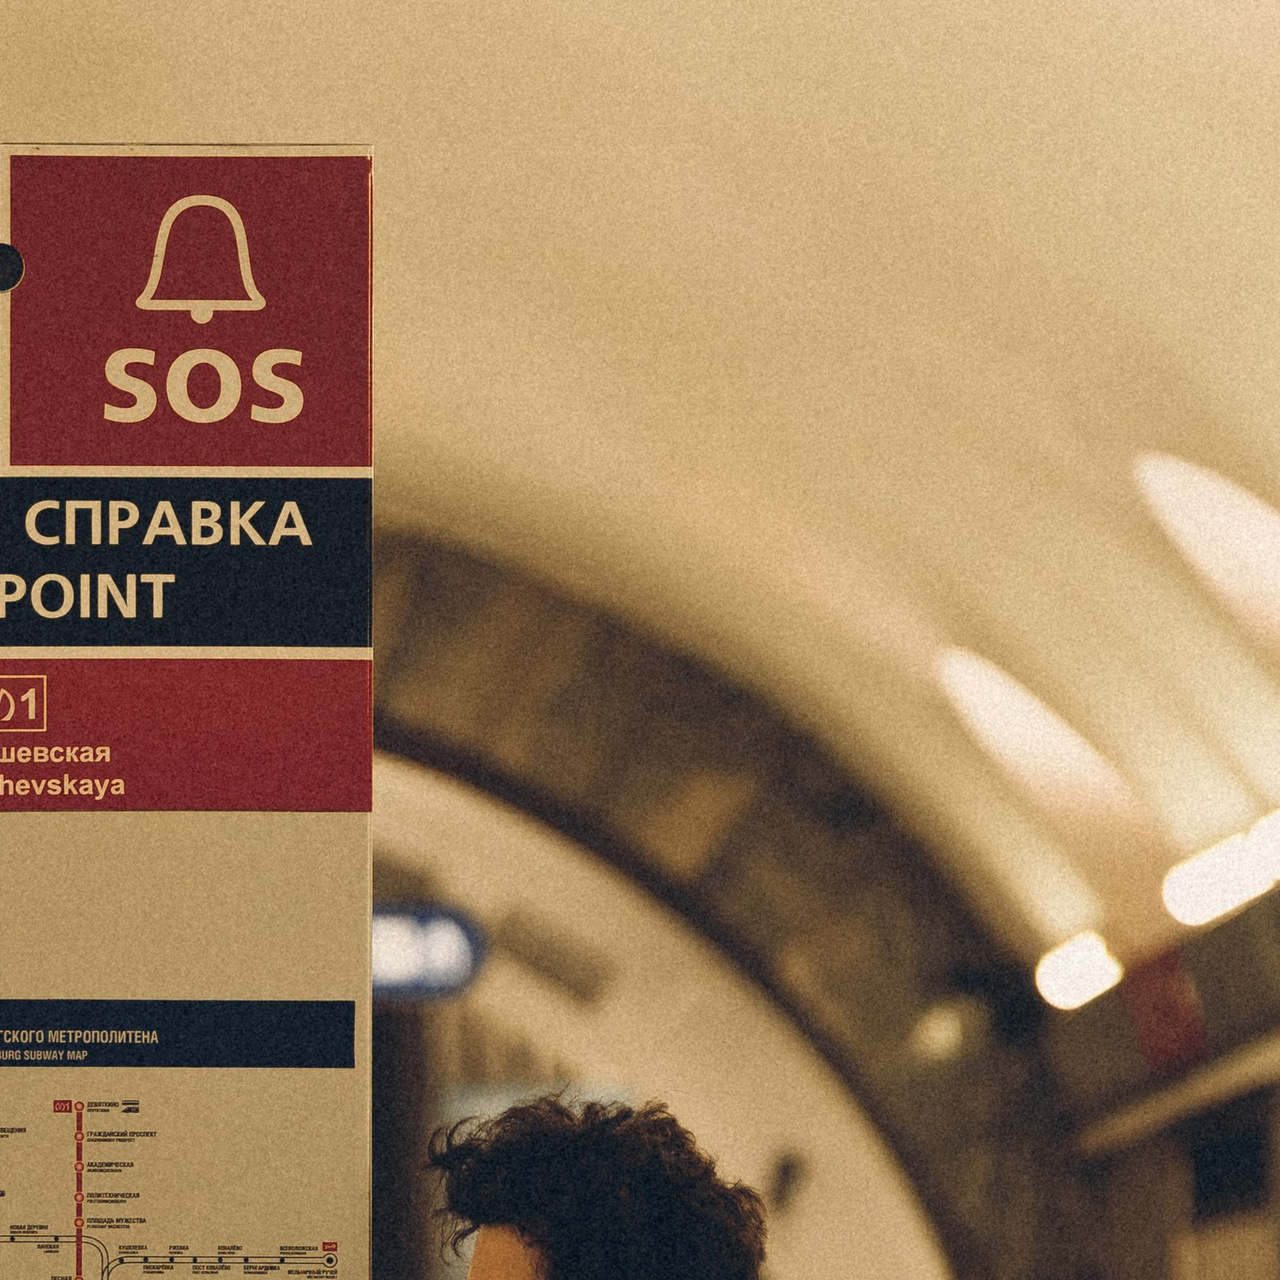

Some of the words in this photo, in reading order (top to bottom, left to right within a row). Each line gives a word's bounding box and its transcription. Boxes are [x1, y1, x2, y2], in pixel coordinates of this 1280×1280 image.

[103, 348, 305, 424] SOS
[23, 499, 313, 546] СПРАВКА
[48, 1029, 159, 1043] МЕТРОПОЛИТЕНА
[24, 1050, 64, 1060] SUBWAY
[67, 1050, 88, 1060] MAP
